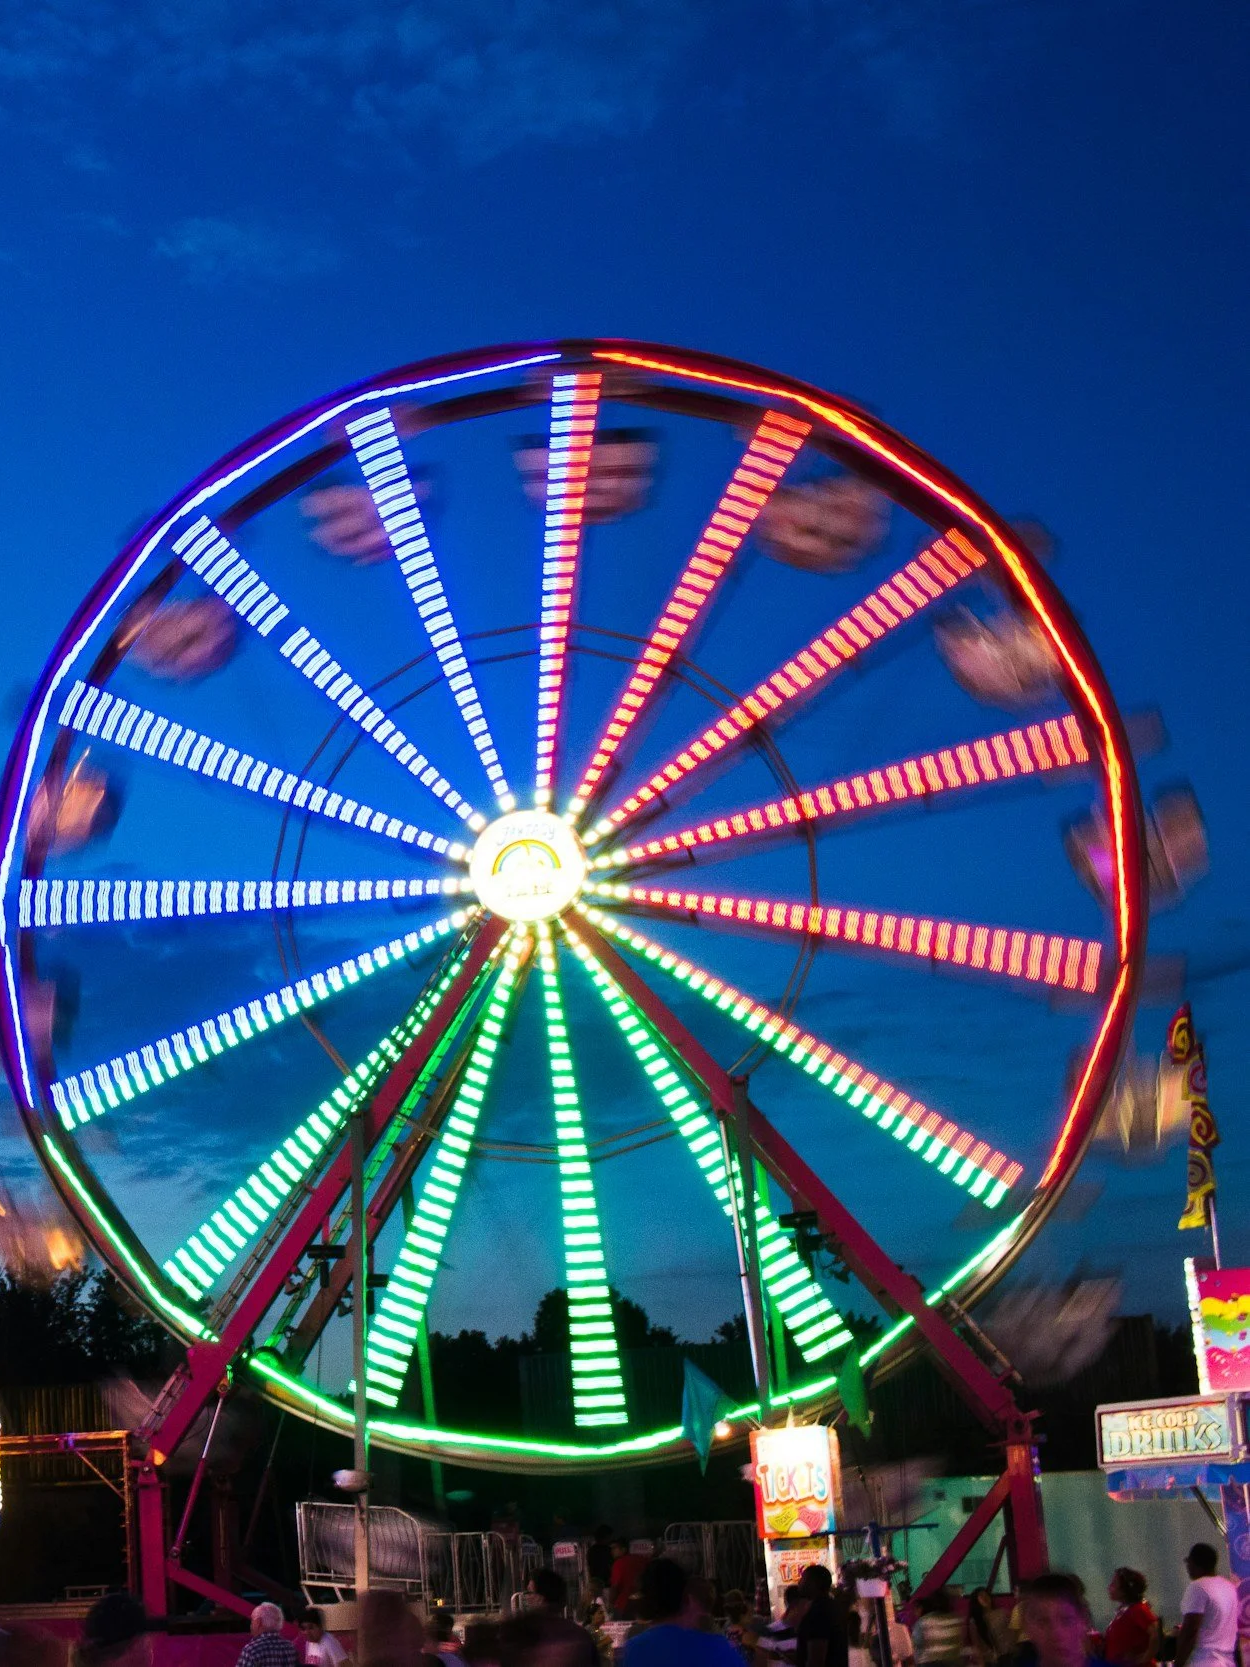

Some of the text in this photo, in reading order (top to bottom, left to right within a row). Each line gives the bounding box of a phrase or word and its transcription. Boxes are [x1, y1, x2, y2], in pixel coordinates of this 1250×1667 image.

[1128, 1410, 1198, 1431] ICE COLD
[1109, 1421, 1222, 1457] DRINKS
